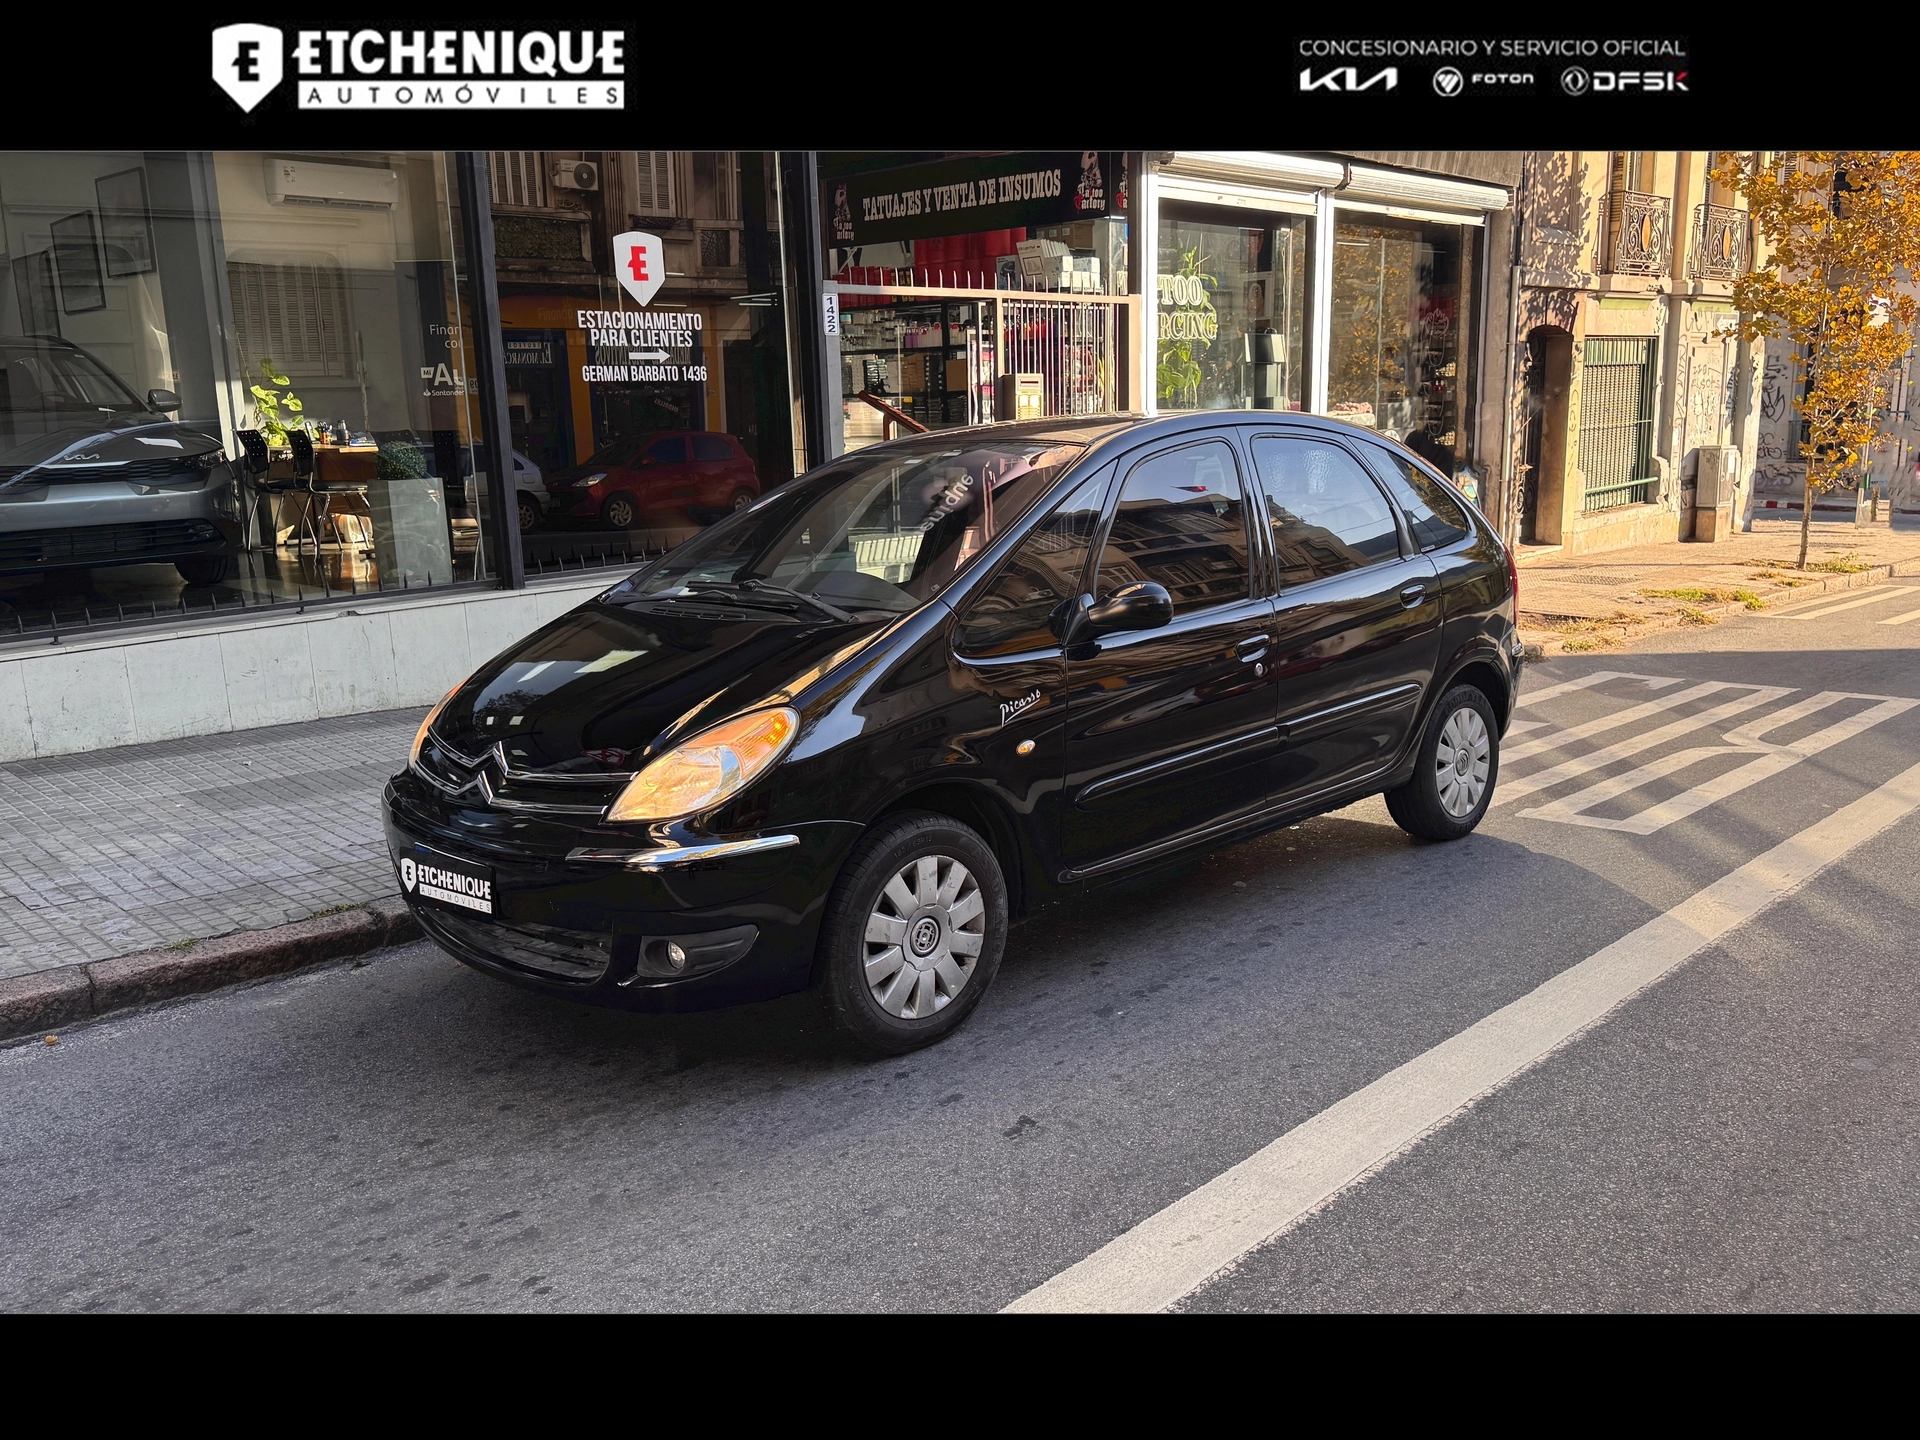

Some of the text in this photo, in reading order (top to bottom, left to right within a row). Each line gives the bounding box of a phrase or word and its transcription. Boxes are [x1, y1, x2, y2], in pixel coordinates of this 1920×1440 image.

[862, 168, 1062, 222] TATUAJES Y VENTA DE INSUMOS
[1157, 275, 1203, 305] TOO
[577, 310, 703, 330] ESTACIONAMIENTO
[825, 296, 837, 334] 1422
[590, 329, 693, 348] PARA CLIENTES
[582, 365, 708, 382] GERMAN BARBATO 1436
[431, 389, 465, 397] Santander
[999, 688, 1042, 728] Picasso
[417, 864, 492, 900] ETCHENIQUE
